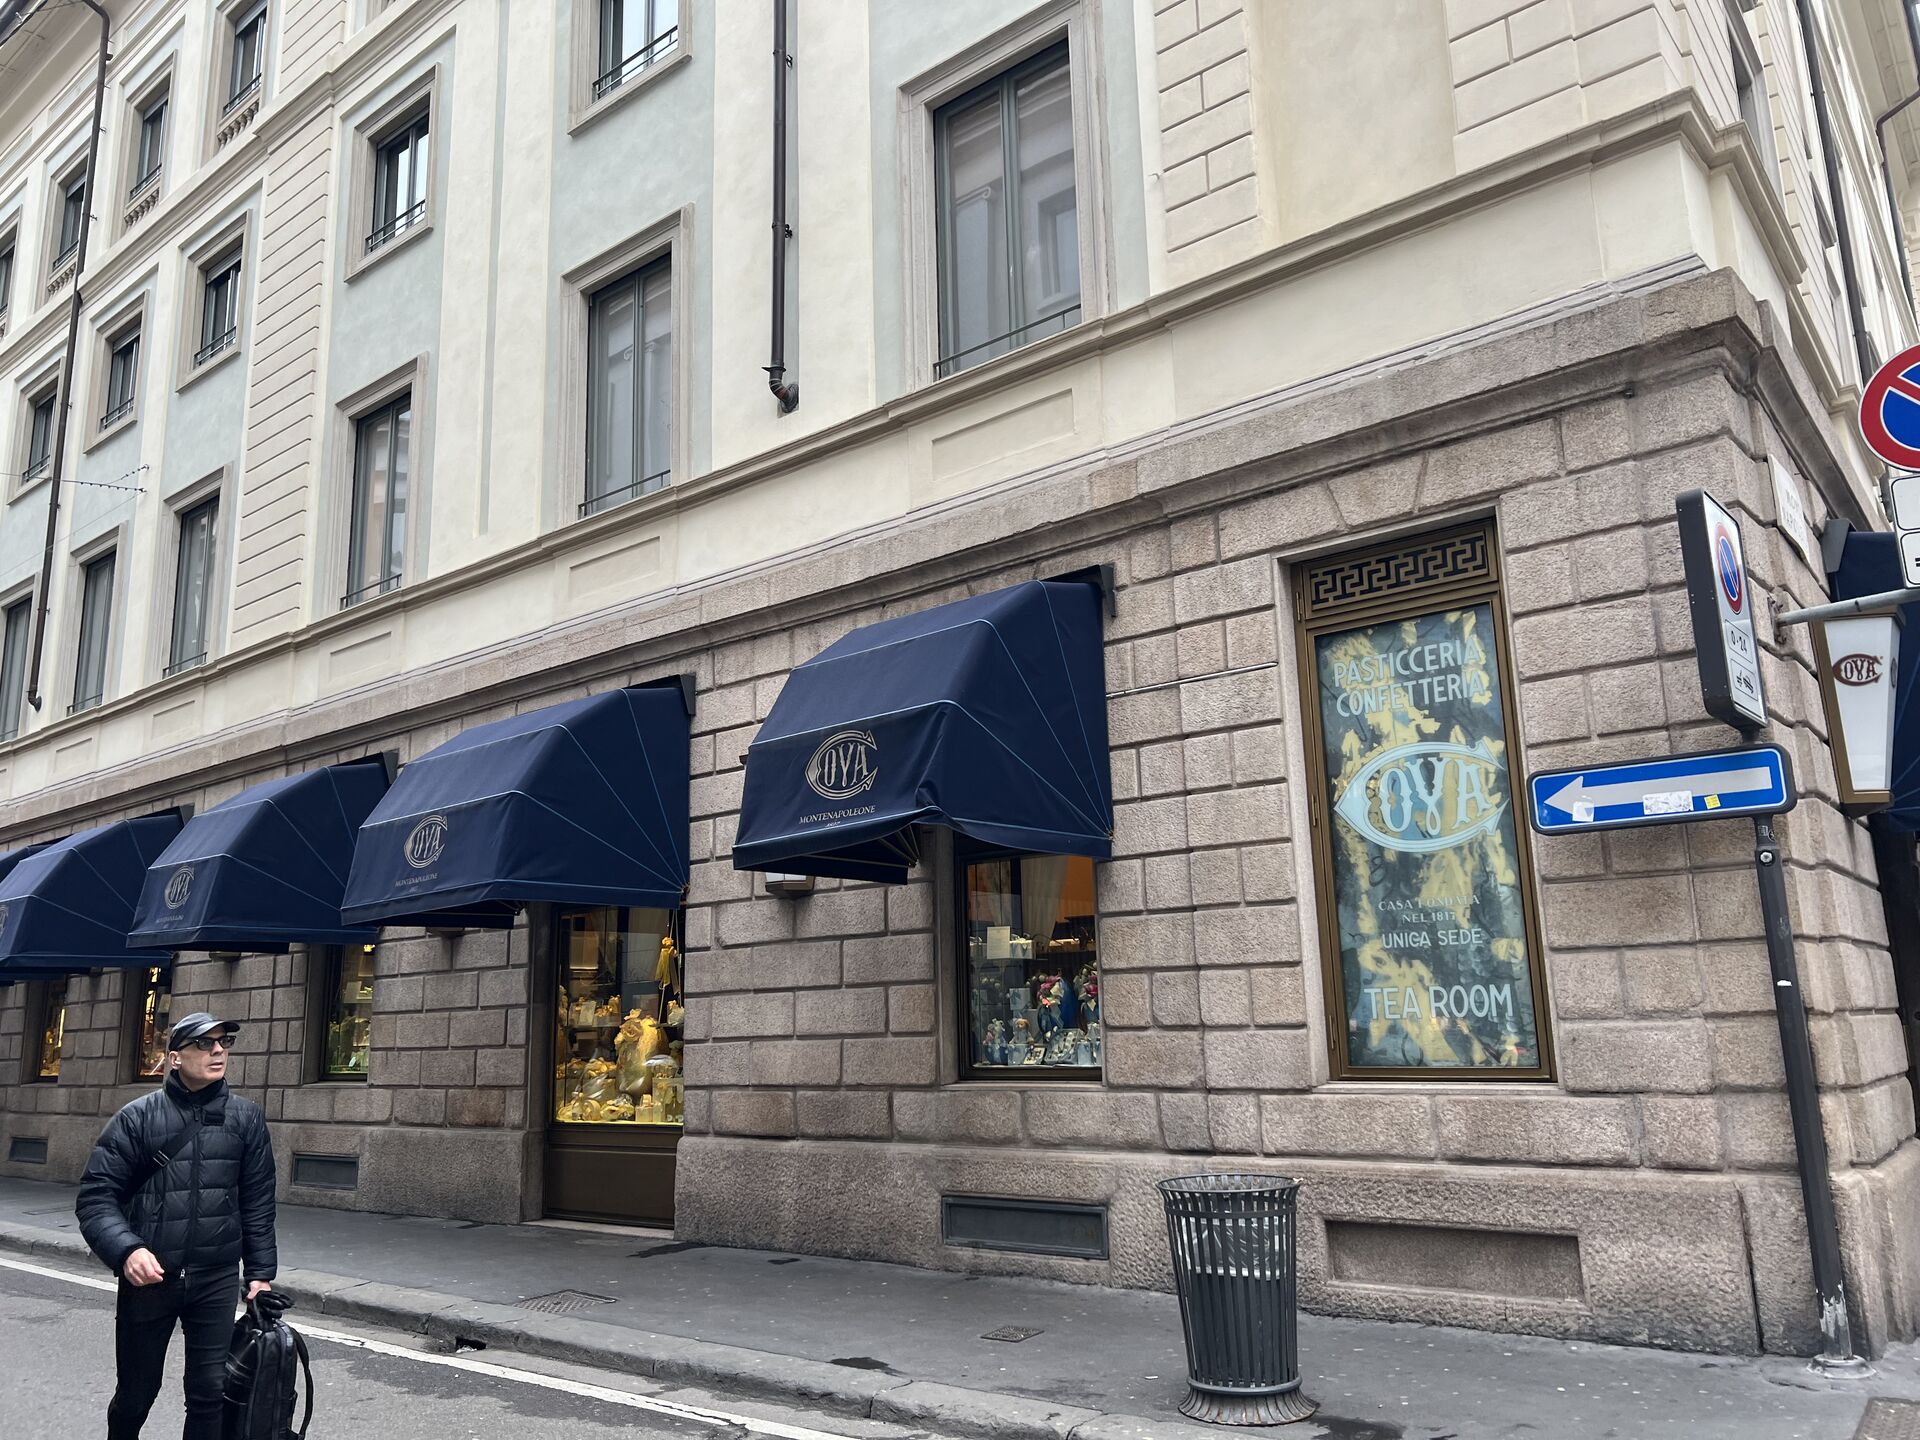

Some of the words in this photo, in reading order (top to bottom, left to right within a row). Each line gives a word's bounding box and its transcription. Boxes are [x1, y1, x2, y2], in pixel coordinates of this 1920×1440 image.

[1333, 634, 1481, 688] PASTICCERIA
[1336, 670, 1486, 718] CONFETTERIA
[798, 805, 876, 824] MONTENAPOLEONE
[1377, 899, 1414, 912] CASA
[1402, 913, 1428, 924] NEL
[1431, 911, 1457, 922] 1817
[1382, 931, 1432, 949] UNICA
[1437, 928, 1483, 946] SEDE
[1364, 986, 1423, 1020] TEA
[1429, 983, 1514, 1019] ROOM
